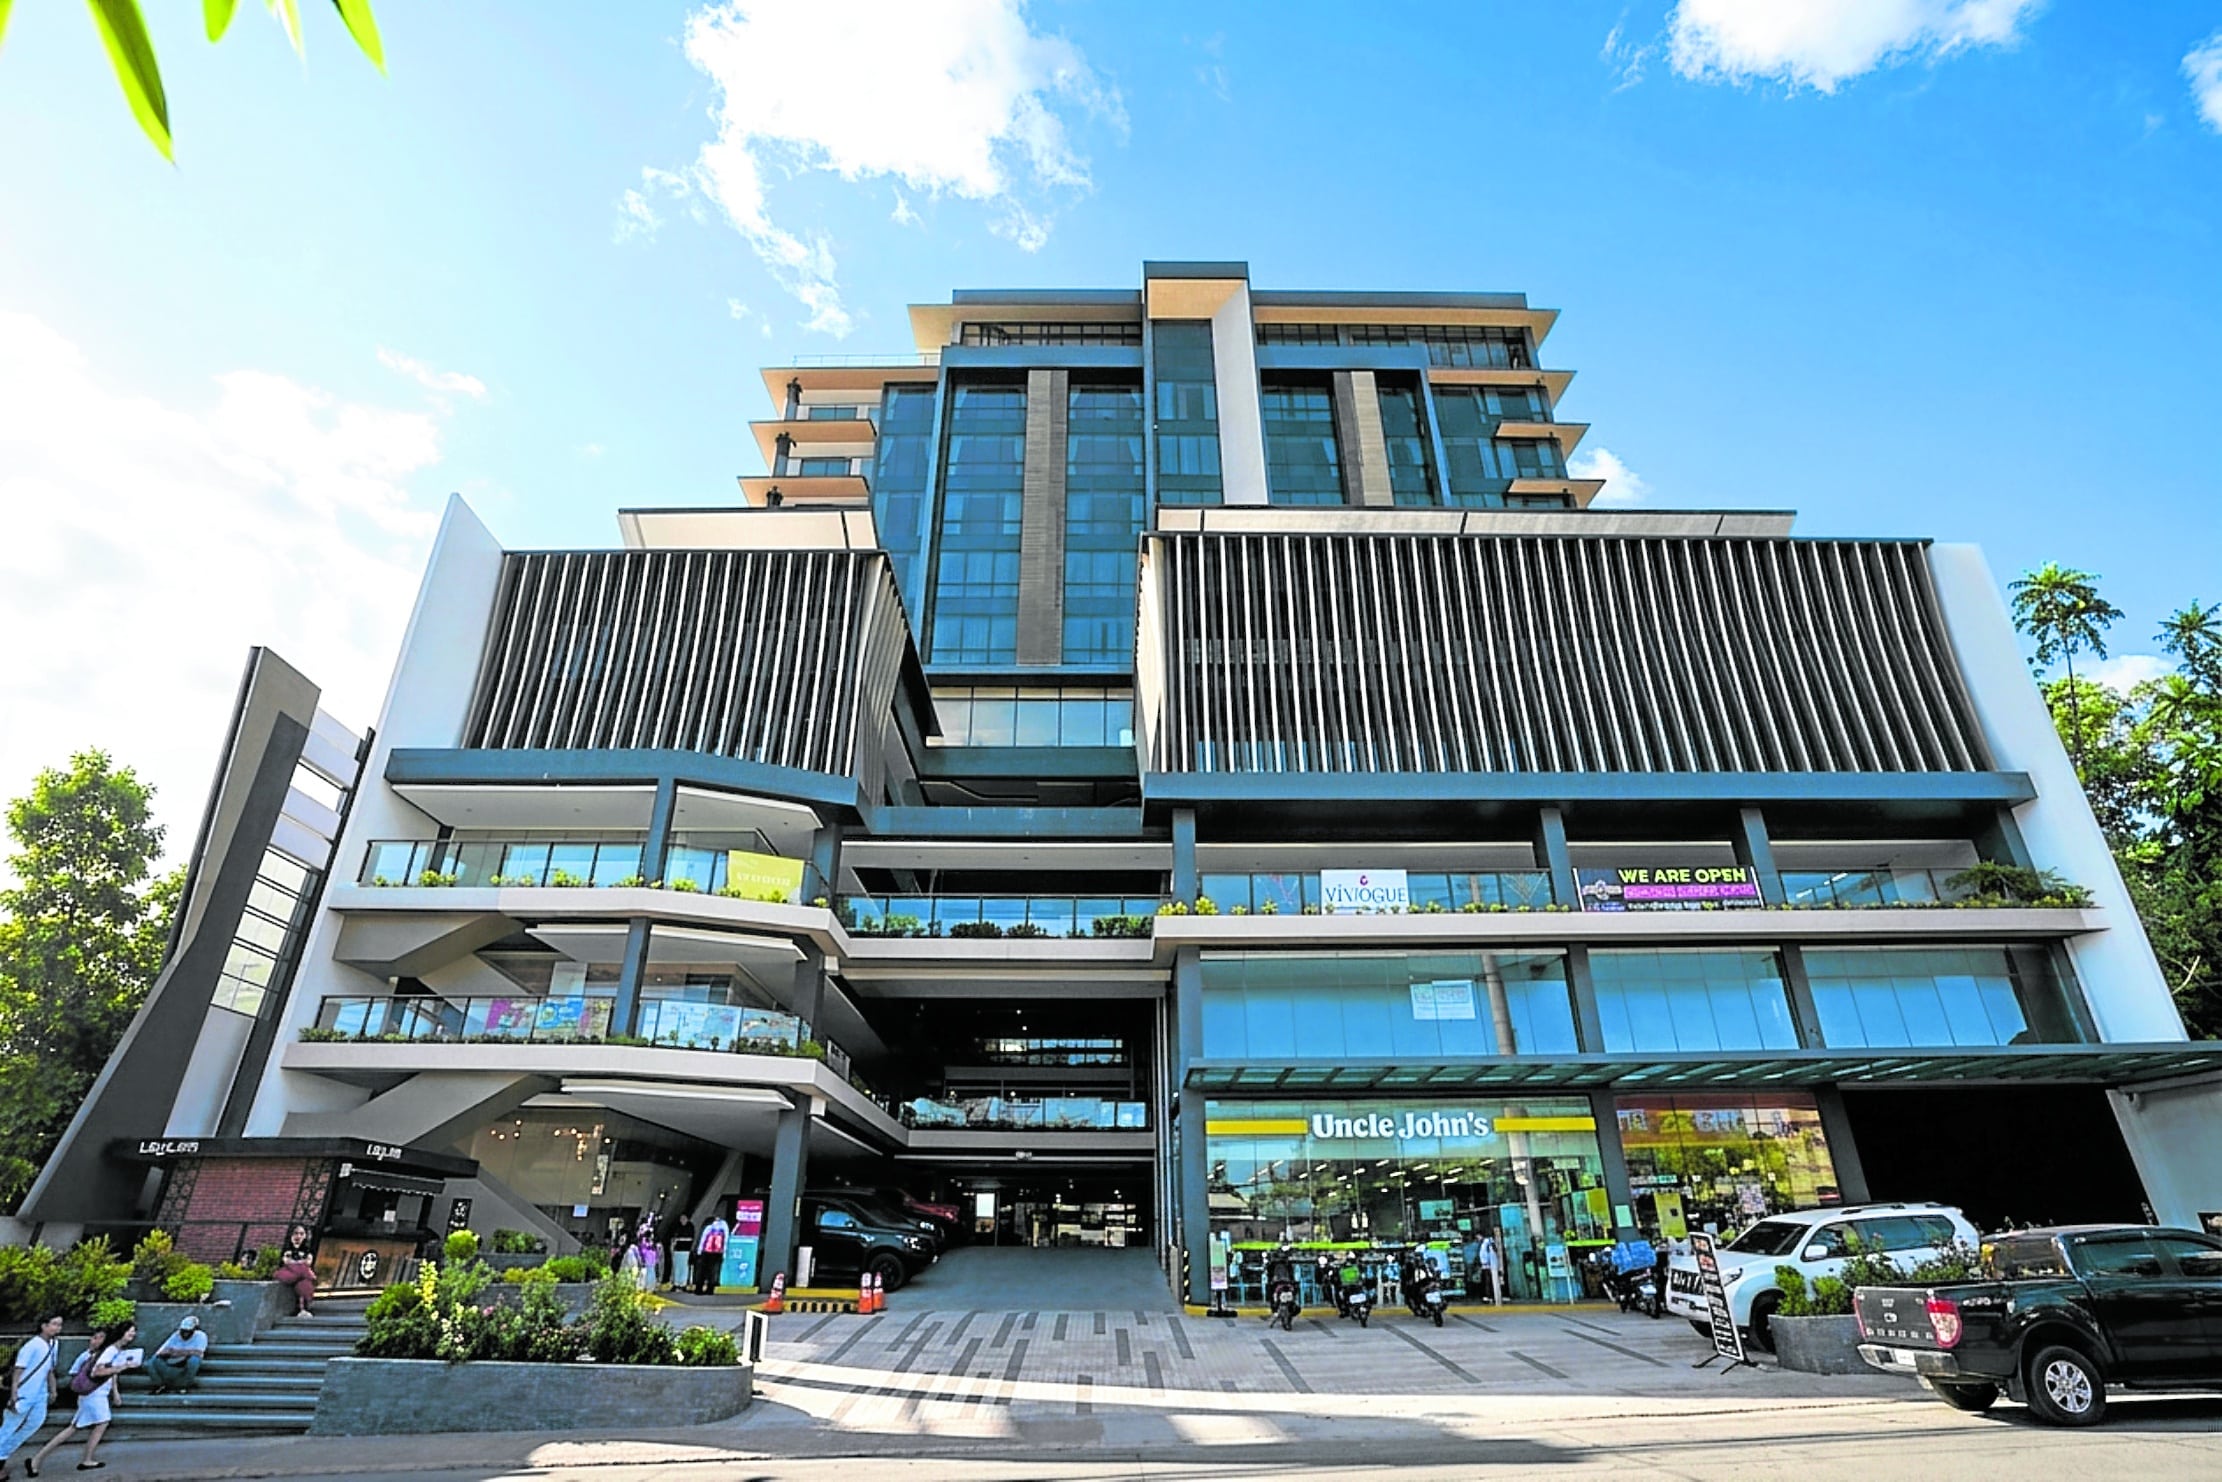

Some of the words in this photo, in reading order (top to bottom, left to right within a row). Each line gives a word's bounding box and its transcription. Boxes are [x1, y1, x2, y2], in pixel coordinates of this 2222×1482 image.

[1617, 868, 1649, 883] WE
[1654, 868, 1691, 883] ARE
[1695, 867, 1747, 883] OPEN
[1312, 1113, 1394, 1138] Uncle
[1398, 1112, 1489, 1139] John's
